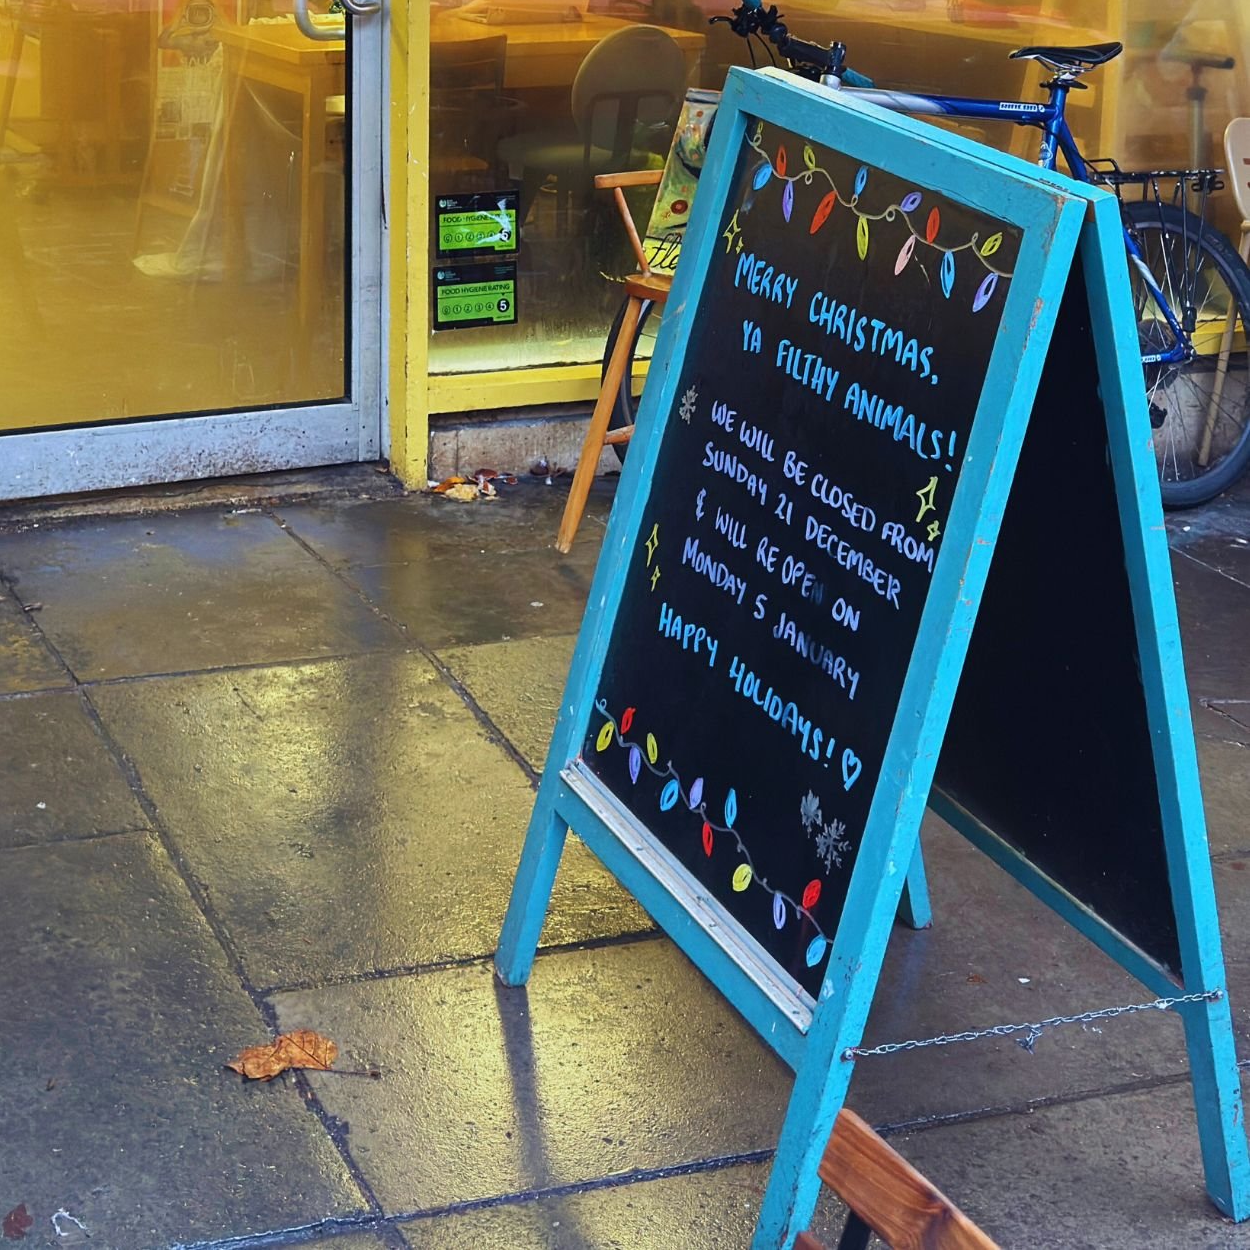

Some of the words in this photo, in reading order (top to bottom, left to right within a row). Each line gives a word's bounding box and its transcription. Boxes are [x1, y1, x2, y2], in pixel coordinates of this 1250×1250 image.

[500, 300, 506, 311] 5
[734, 252, 798, 309] MERRY
[809, 292, 938, 385] CHRISTMAS,
[742, 319, 762, 353] YA
[776, 339, 839, 401] FILTHY
[844, 382, 956, 471] ANIMALS!
[702, 441, 767, 506] SUNDAY
[774, 494, 793, 525] 21
[805, 516, 901, 610] DECEMBER
[711, 400, 737, 432] WE
[740, 421, 775, 462] WILL
[783, 451, 808, 485] BE
[811, 474, 876, 532] CLOSED
[881, 521, 934, 573] FROM
[682, 537, 747, 605] MONDAY
[753, 594, 767, 620] 5
[772, 613, 860, 700] JANUARY
[715, 507, 747, 549] WILL
[781, 555, 825, 604] OPEN
[831, 598, 861, 630] ON
[658, 602, 718, 668] HAPPY
[729, 656, 836, 768] HOLIDAYS!
